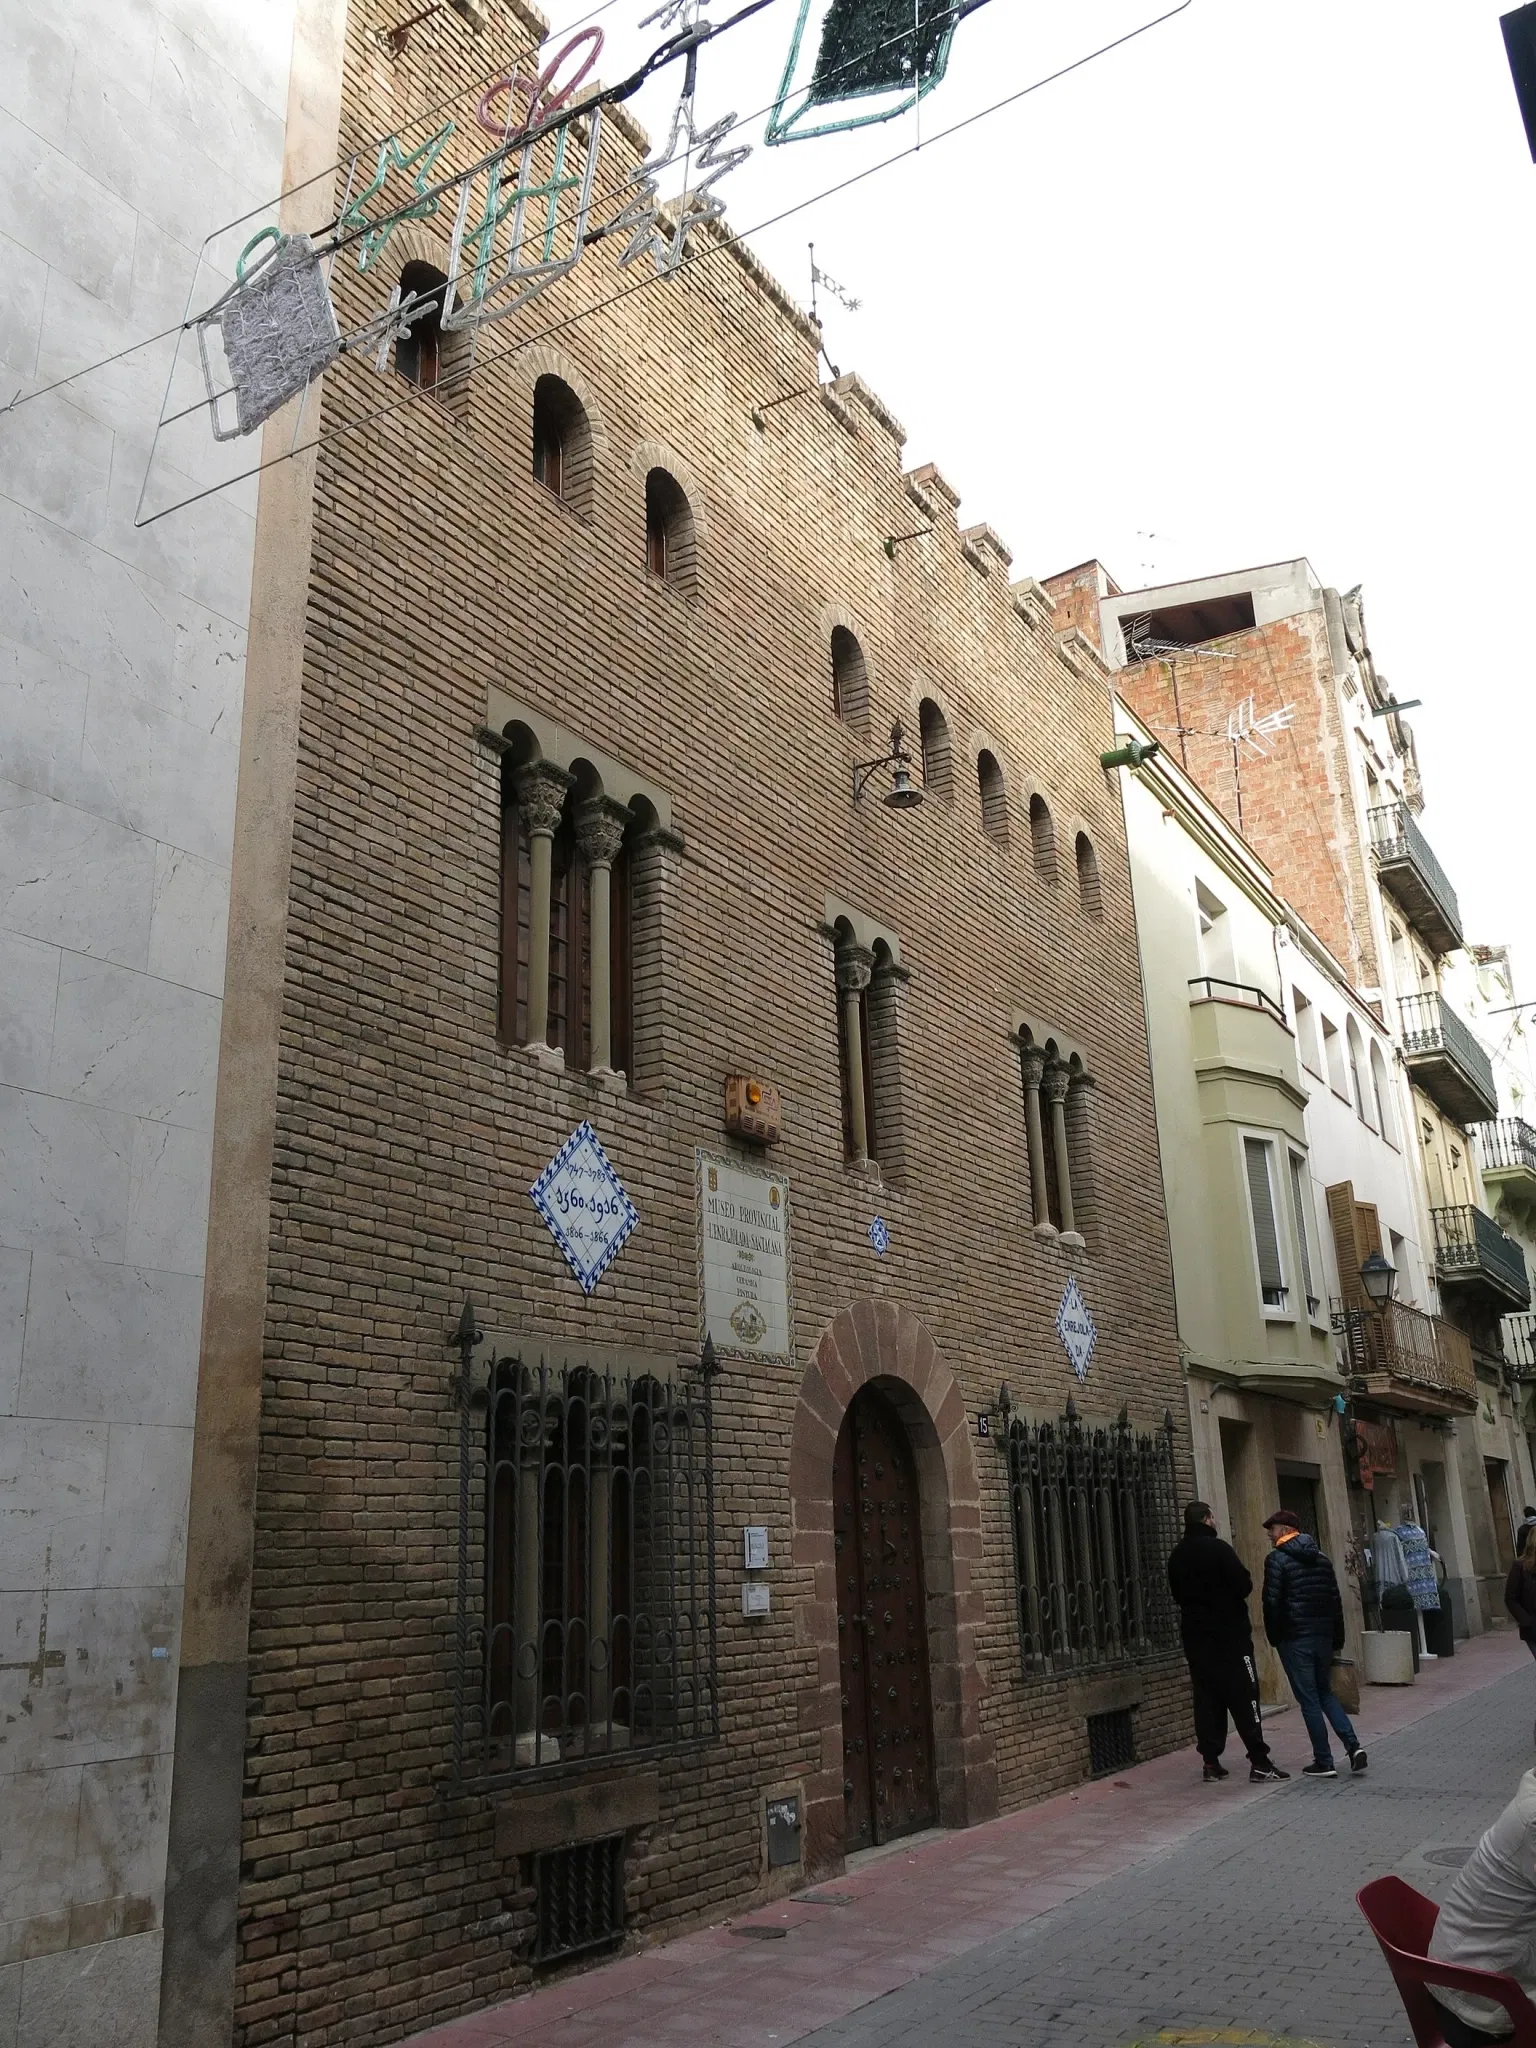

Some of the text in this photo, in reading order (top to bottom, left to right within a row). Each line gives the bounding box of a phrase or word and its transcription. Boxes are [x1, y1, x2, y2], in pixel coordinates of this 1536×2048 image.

[708, 1197, 781, 1232] MUSEO PROVINCIAL
[979, 1417, 988, 1433] 15
